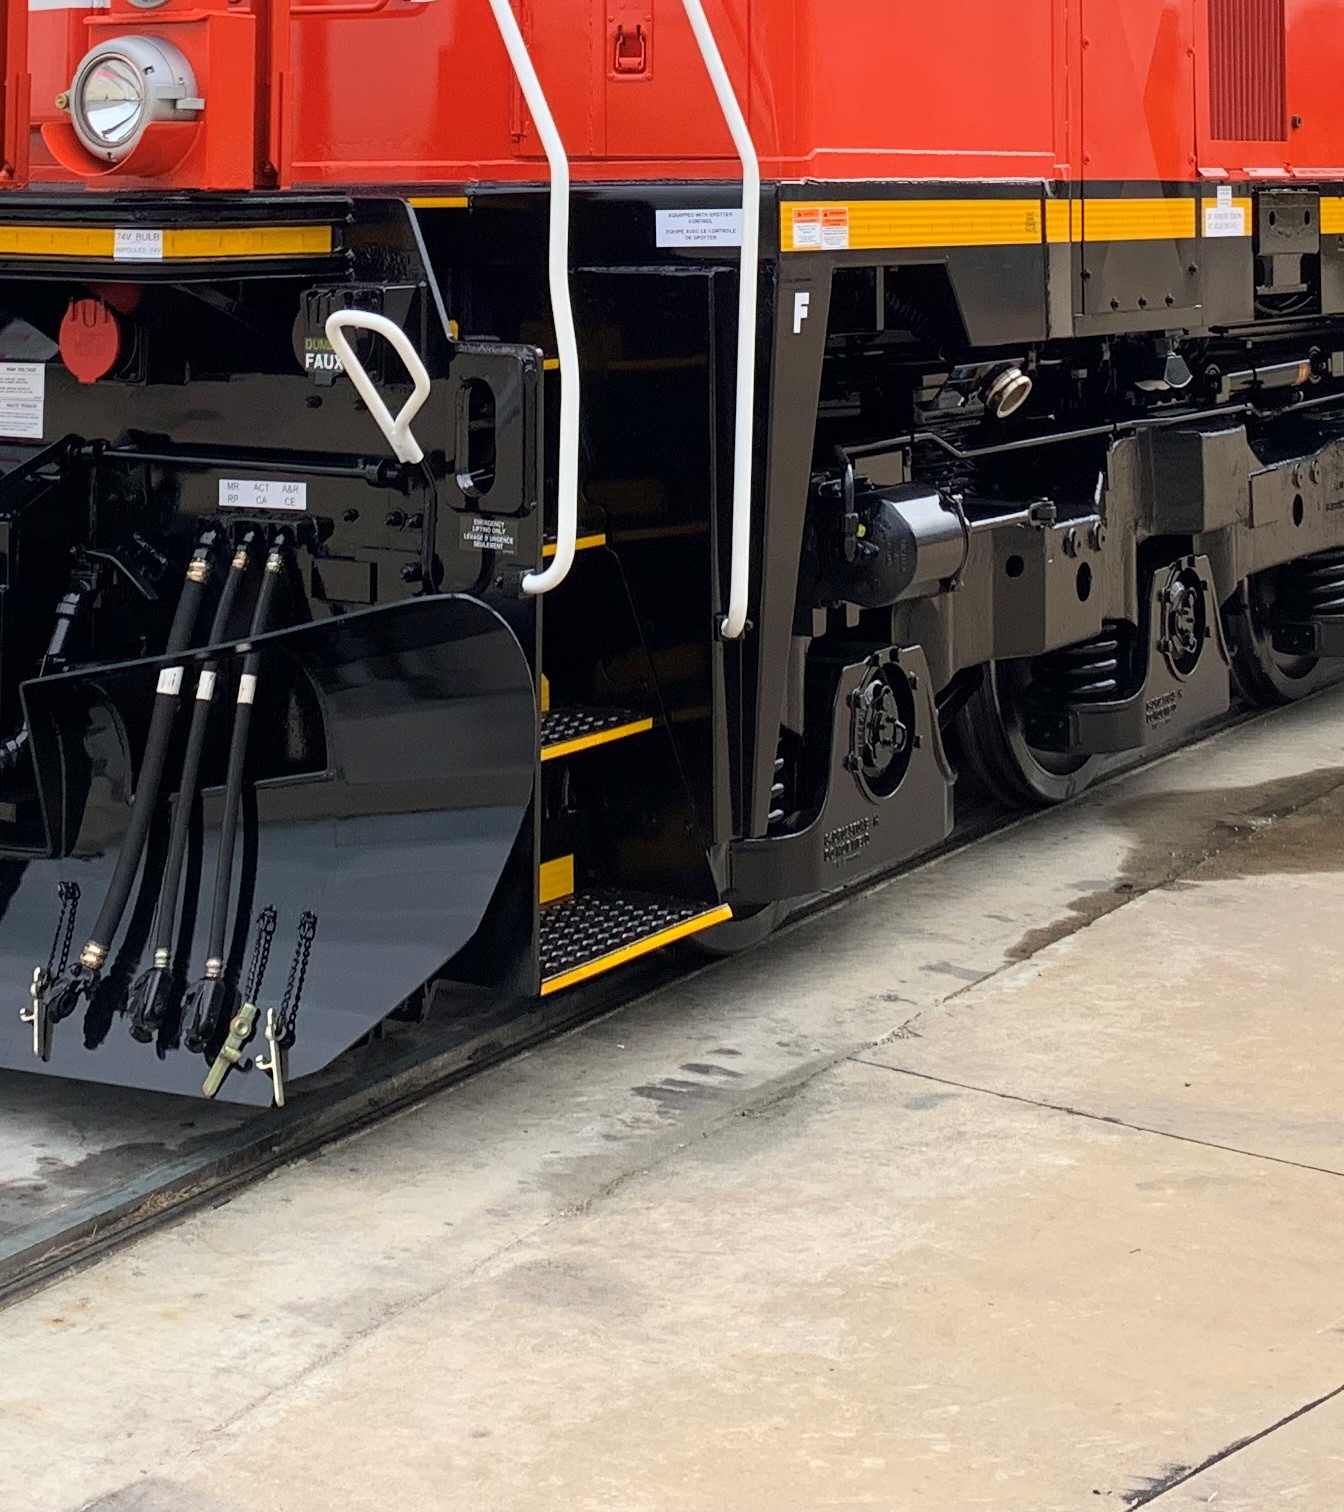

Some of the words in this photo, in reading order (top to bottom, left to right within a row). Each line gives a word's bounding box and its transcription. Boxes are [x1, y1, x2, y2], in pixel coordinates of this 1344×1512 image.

[136, 232, 160, 242] BULB
[793, 292, 810, 334] F
[305, 353, 344, 370] FAUX
[227, 482, 239, 491] MR
[254, 483, 270, 492] ACT
[282, 484, 299, 494] A&R
[227, 494, 239, 503] RP
[256, 496, 268, 505] CA
[284, 497, 296, 506] CE
